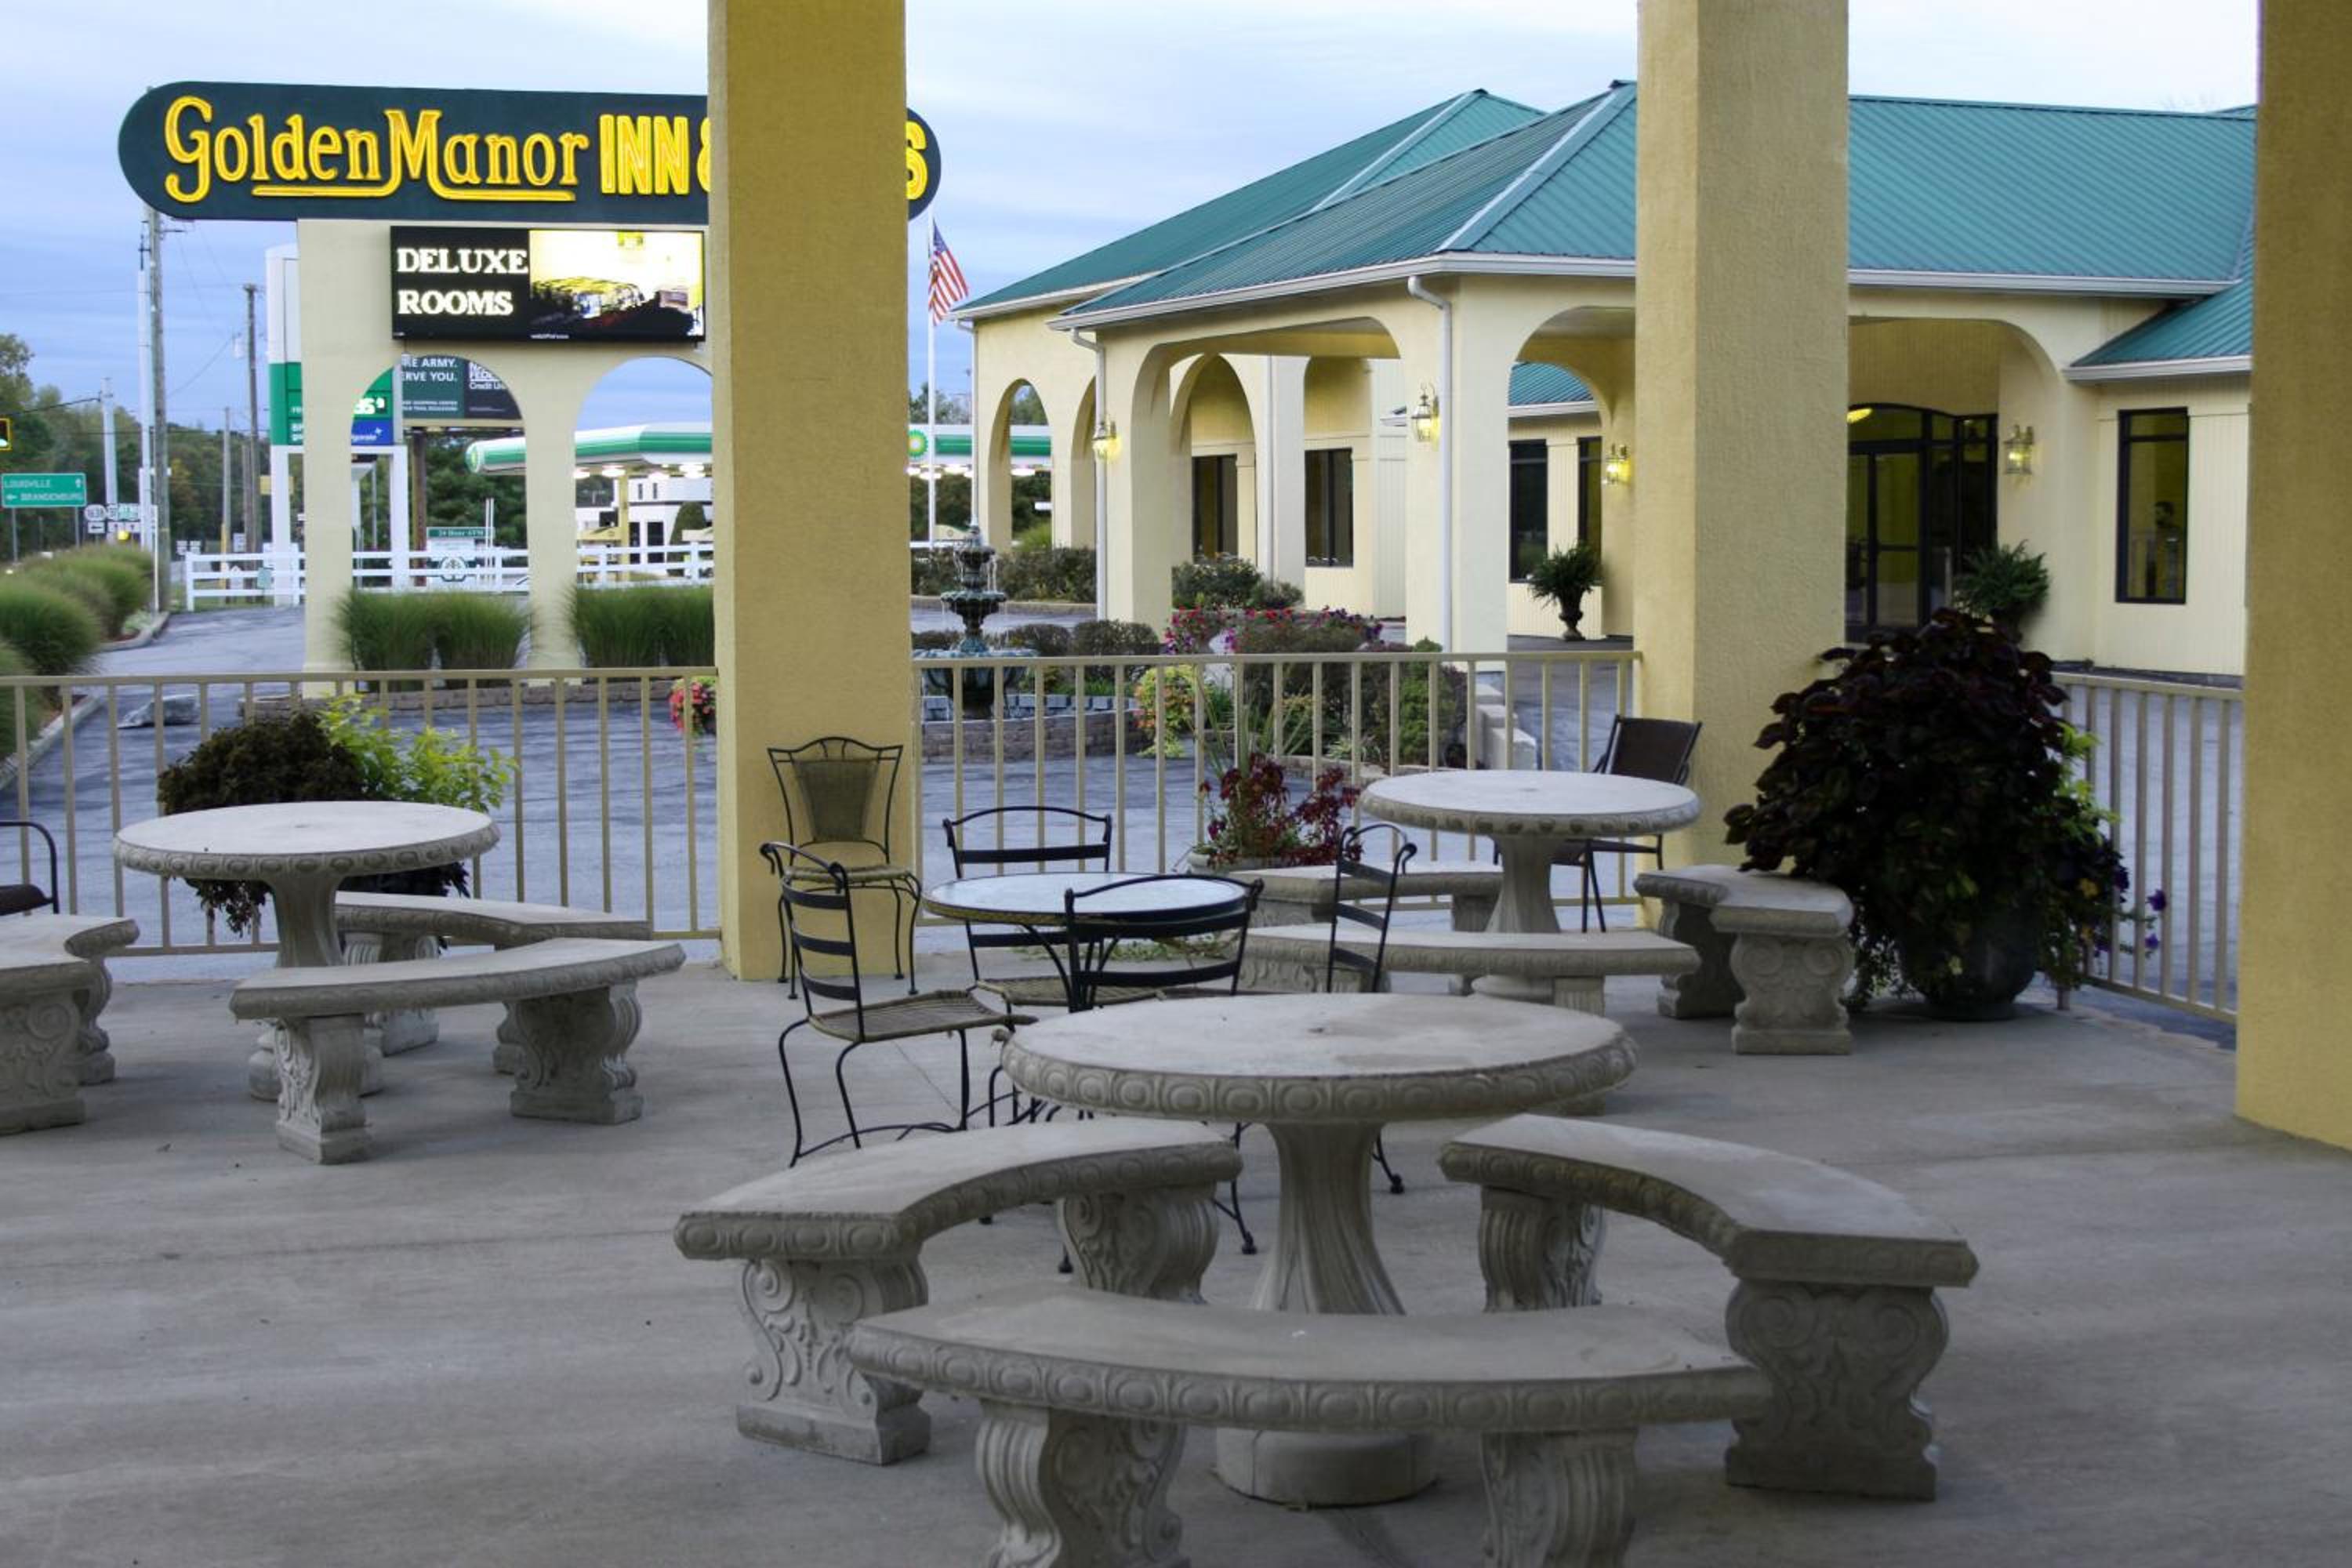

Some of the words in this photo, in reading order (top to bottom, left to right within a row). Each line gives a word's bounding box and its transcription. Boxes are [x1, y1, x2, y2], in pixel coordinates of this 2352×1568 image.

[165, 96, 382, 204] Golden
[384, 108, 590, 201] Manor
[599, 114, 690, 195] INN
[397, 248, 528, 274] DELUXE
[397, 289, 514, 316] ROOMS
